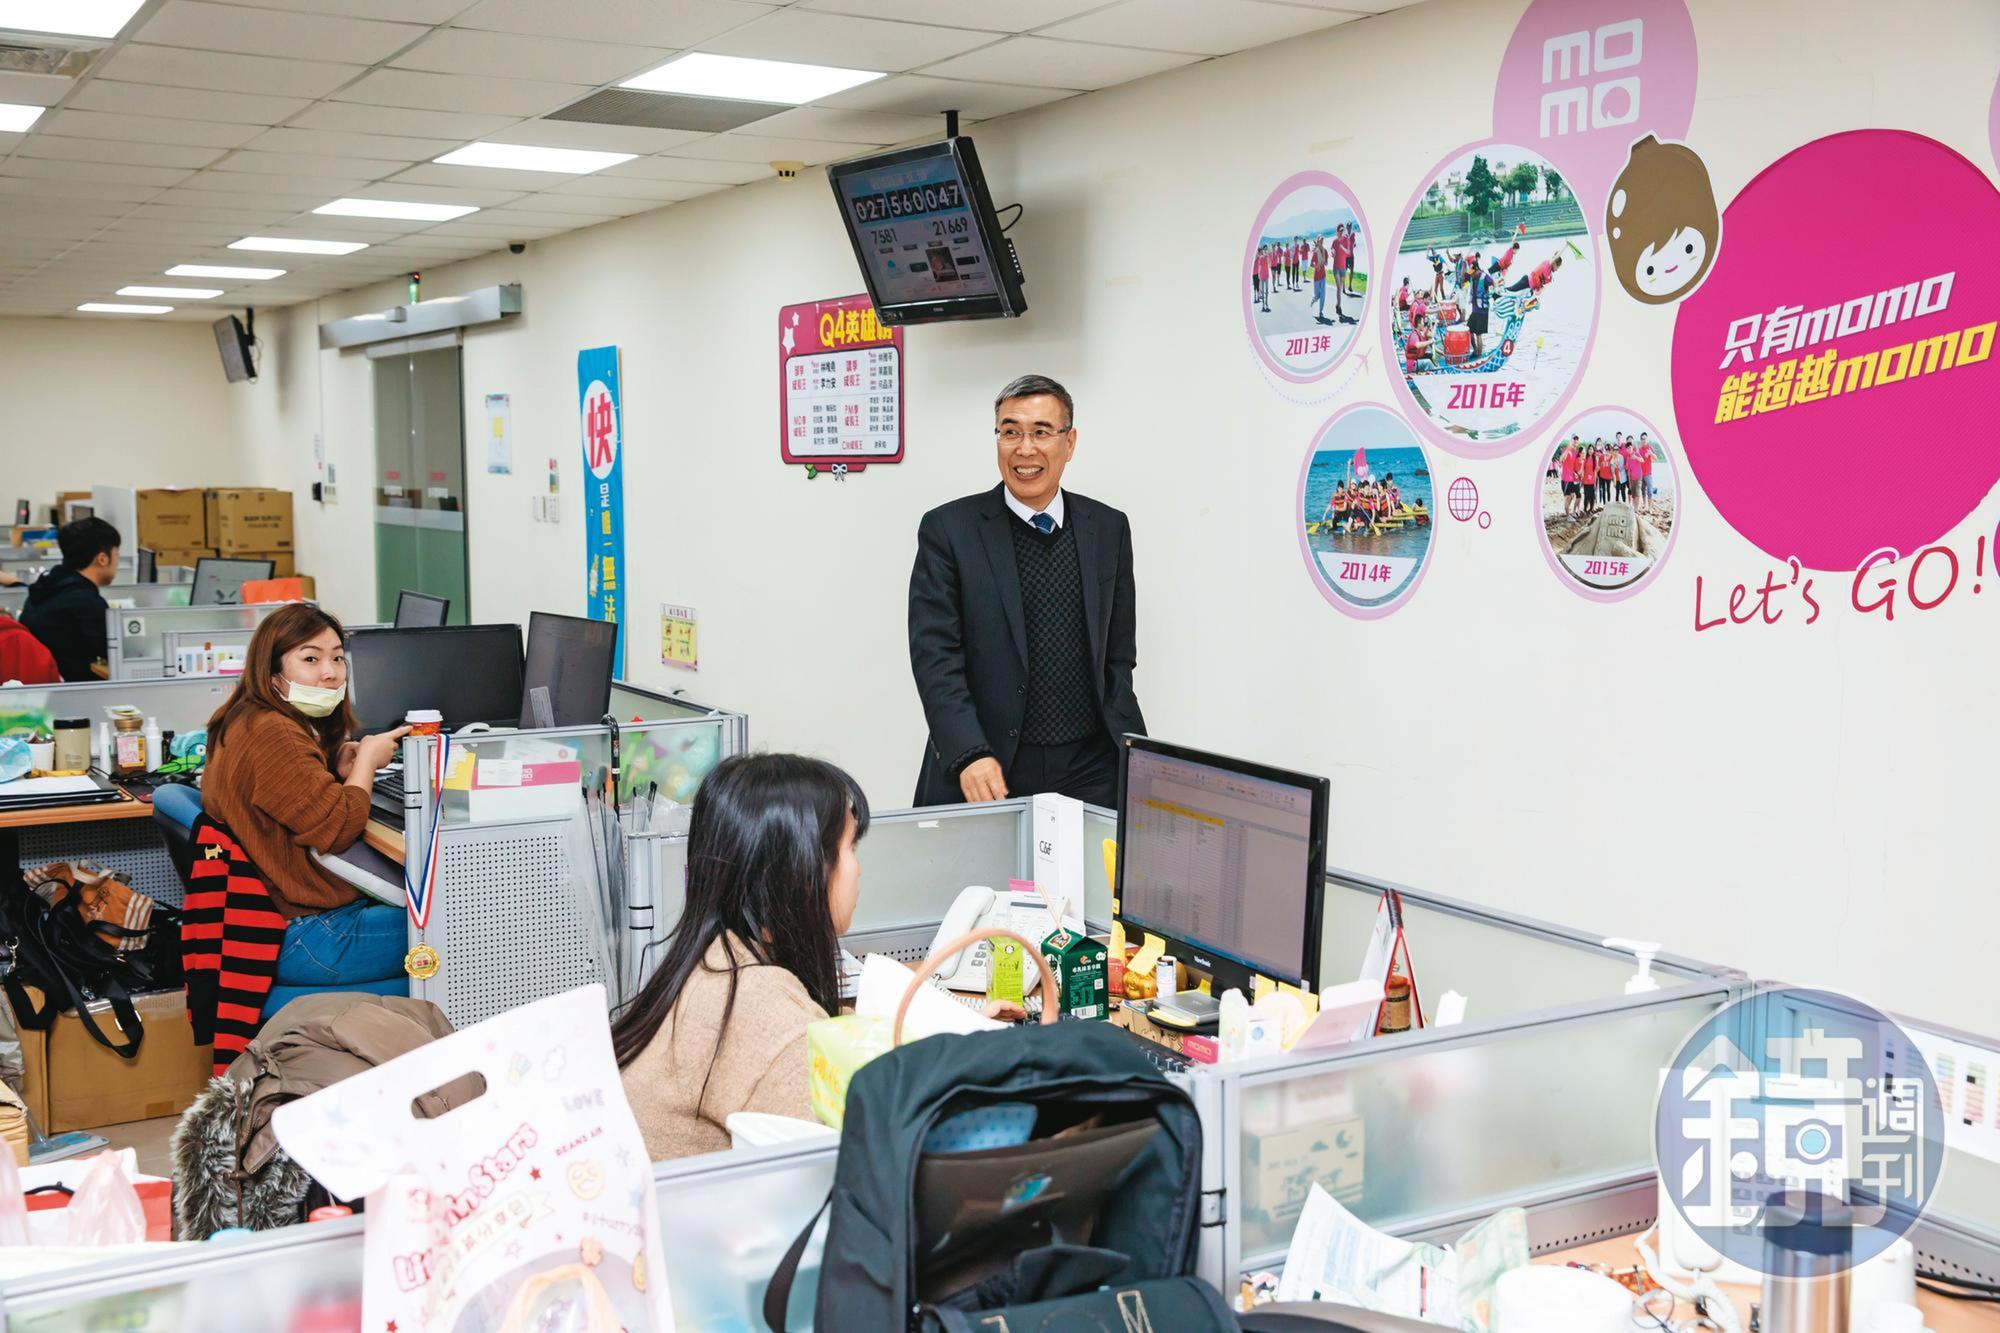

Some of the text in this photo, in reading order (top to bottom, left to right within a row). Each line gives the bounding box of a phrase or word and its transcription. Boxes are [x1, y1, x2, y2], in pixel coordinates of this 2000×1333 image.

[871, 217, 968, 245] 7581 21669
[1719, 272, 1955, 370] 只有momo
[1285, 335, 1331, 356] 2013年
[1714, 321, 1998, 424] 能超越momo
[1447, 382, 1526, 410] 2016年
[587, 392, 612, 469] 快
[1339, 561, 1393, 583] 2014年
[1583, 560, 1631, 577] 2015年
[1694, 535, 1986, 632] Let's GO!
